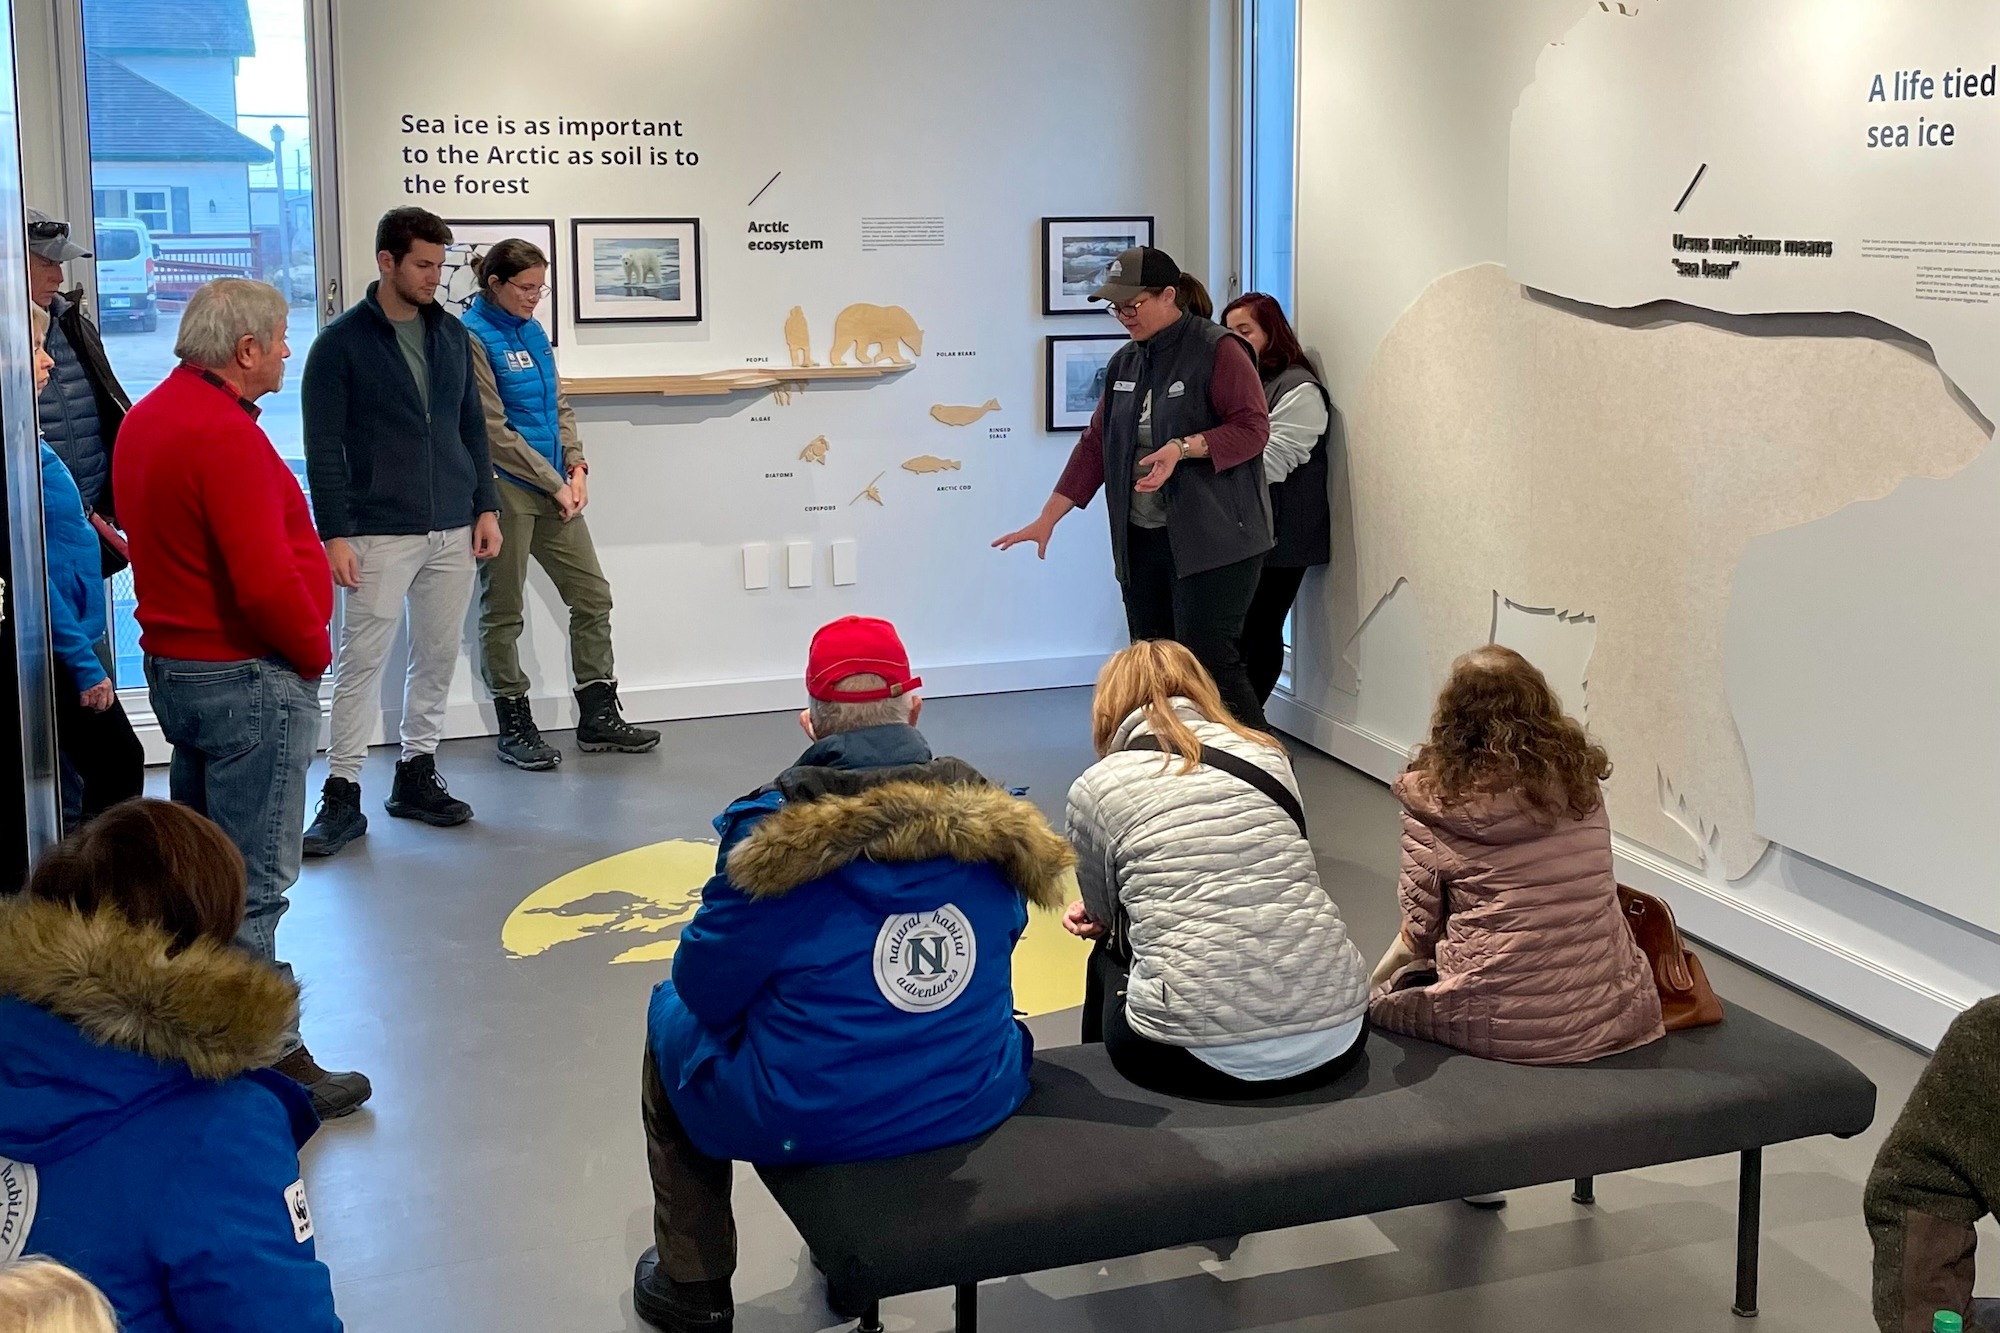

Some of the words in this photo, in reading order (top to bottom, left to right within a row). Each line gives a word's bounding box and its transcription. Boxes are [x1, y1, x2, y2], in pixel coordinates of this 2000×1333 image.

[1867, 73, 1886, 103] A
[1894, 69, 1935, 101] life
[1942, 64, 1997, 99] tied
[401, 114, 446, 135] Sea
[454, 114, 489, 135] ice
[497, 114, 516, 135] is
[524, 120, 550, 136] as
[558, 115, 683, 141] important
[1866, 124, 1909, 148] sea
[1918, 116, 1955, 147] ice
[402, 146, 429, 165] to
[436, 144, 479, 165] the
[487, 144, 560, 165] Arctic
[567, 150, 594, 166] as
[601, 145, 642, 166] soil
[650, 145, 668, 166] is
[674, 148, 699, 167] to
[403, 173, 446, 195] the
[454, 173, 530, 195] forest
[747, 219, 790, 234] Arctic
[747, 238, 824, 254] ecosystem
[1672, 233, 1710, 253] Ursus
[1711, 234, 1782, 255] maritimus
[1784, 240, 1833, 257] means
[750, 415, 771, 423] ALGAE
[888, 911, 922, 964] natural
[931, 910, 966, 957] habitat
[906, 936, 948, 977] N
[896, 968, 959, 998] adventures
[0, 1162, 23, 1245] habitat
